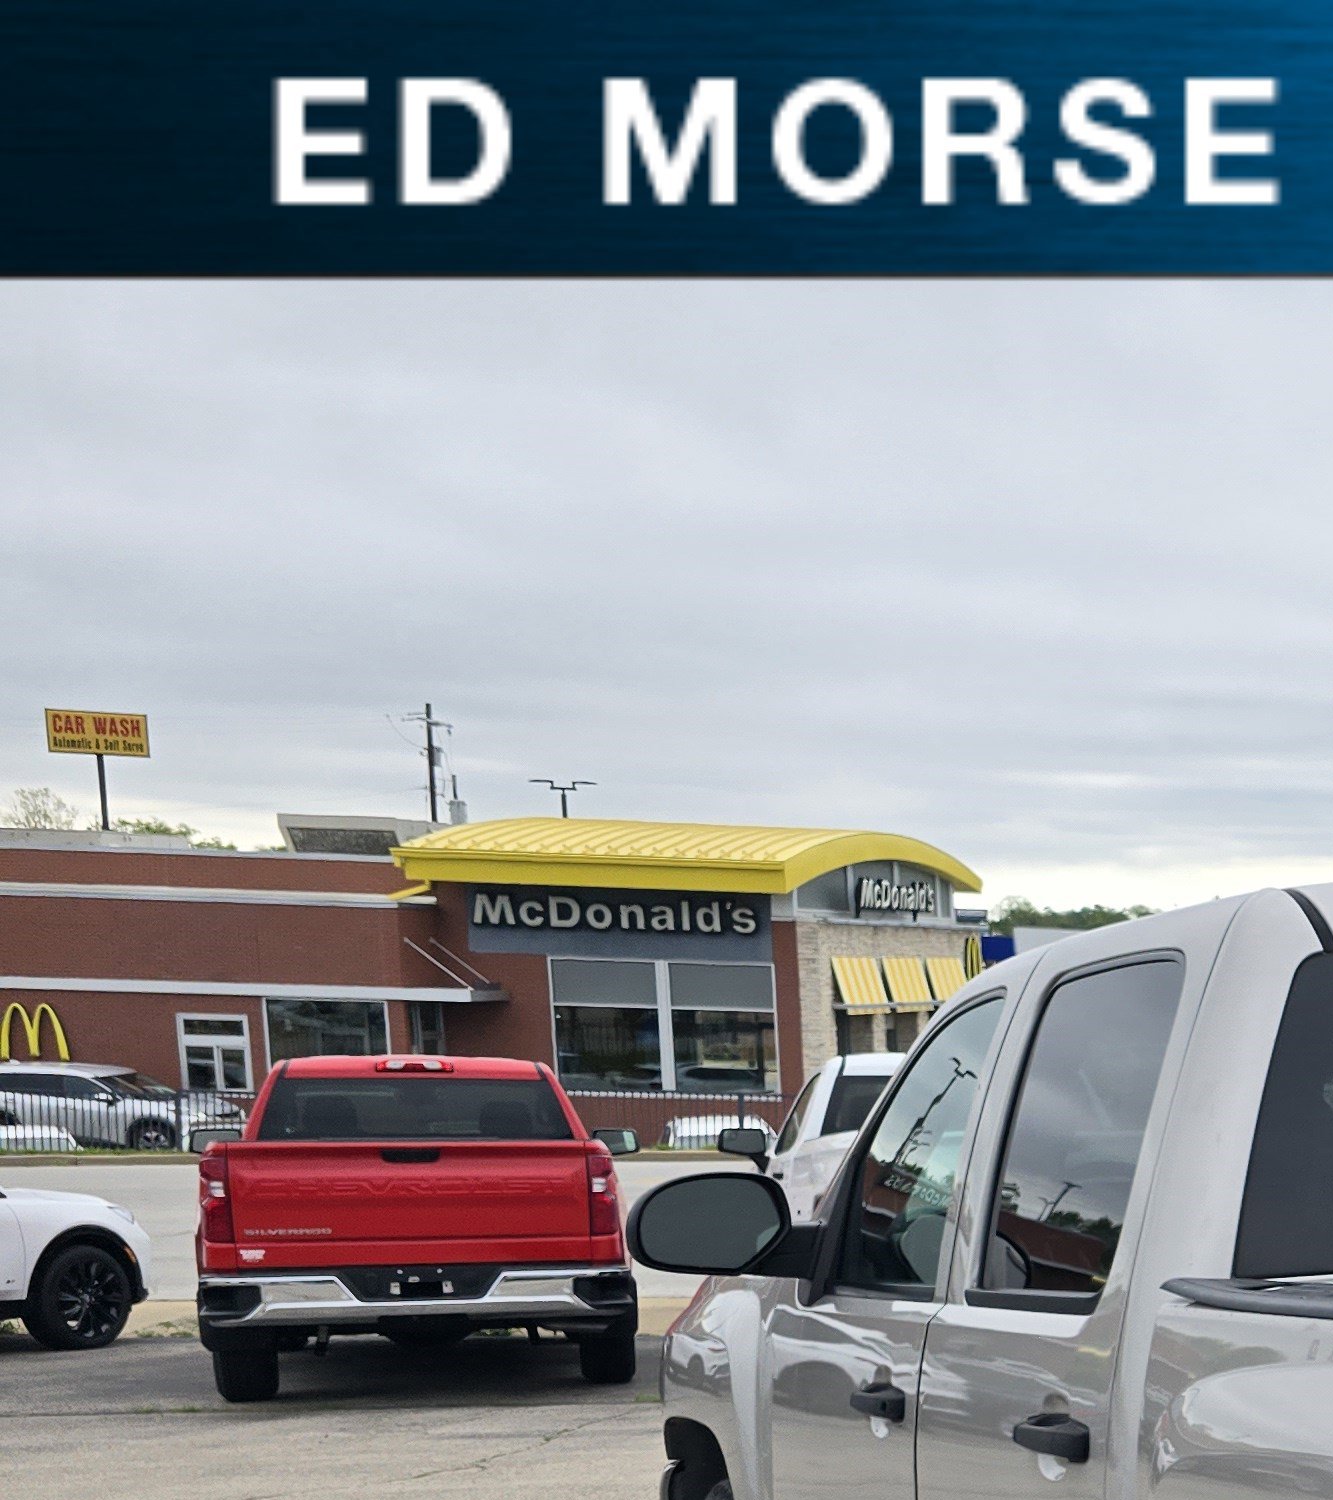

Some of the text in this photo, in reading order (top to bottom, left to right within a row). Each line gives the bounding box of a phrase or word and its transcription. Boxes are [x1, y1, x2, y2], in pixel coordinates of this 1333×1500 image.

[52, 713, 142, 738] CAR WASH
[53, 736, 92, 750] Automatic
[104, 738, 120, 752] Self
[122, 739, 144, 753] Serve
[859, 878, 935, 913] McDonald's
[472, 892, 757, 935] McDonald's
